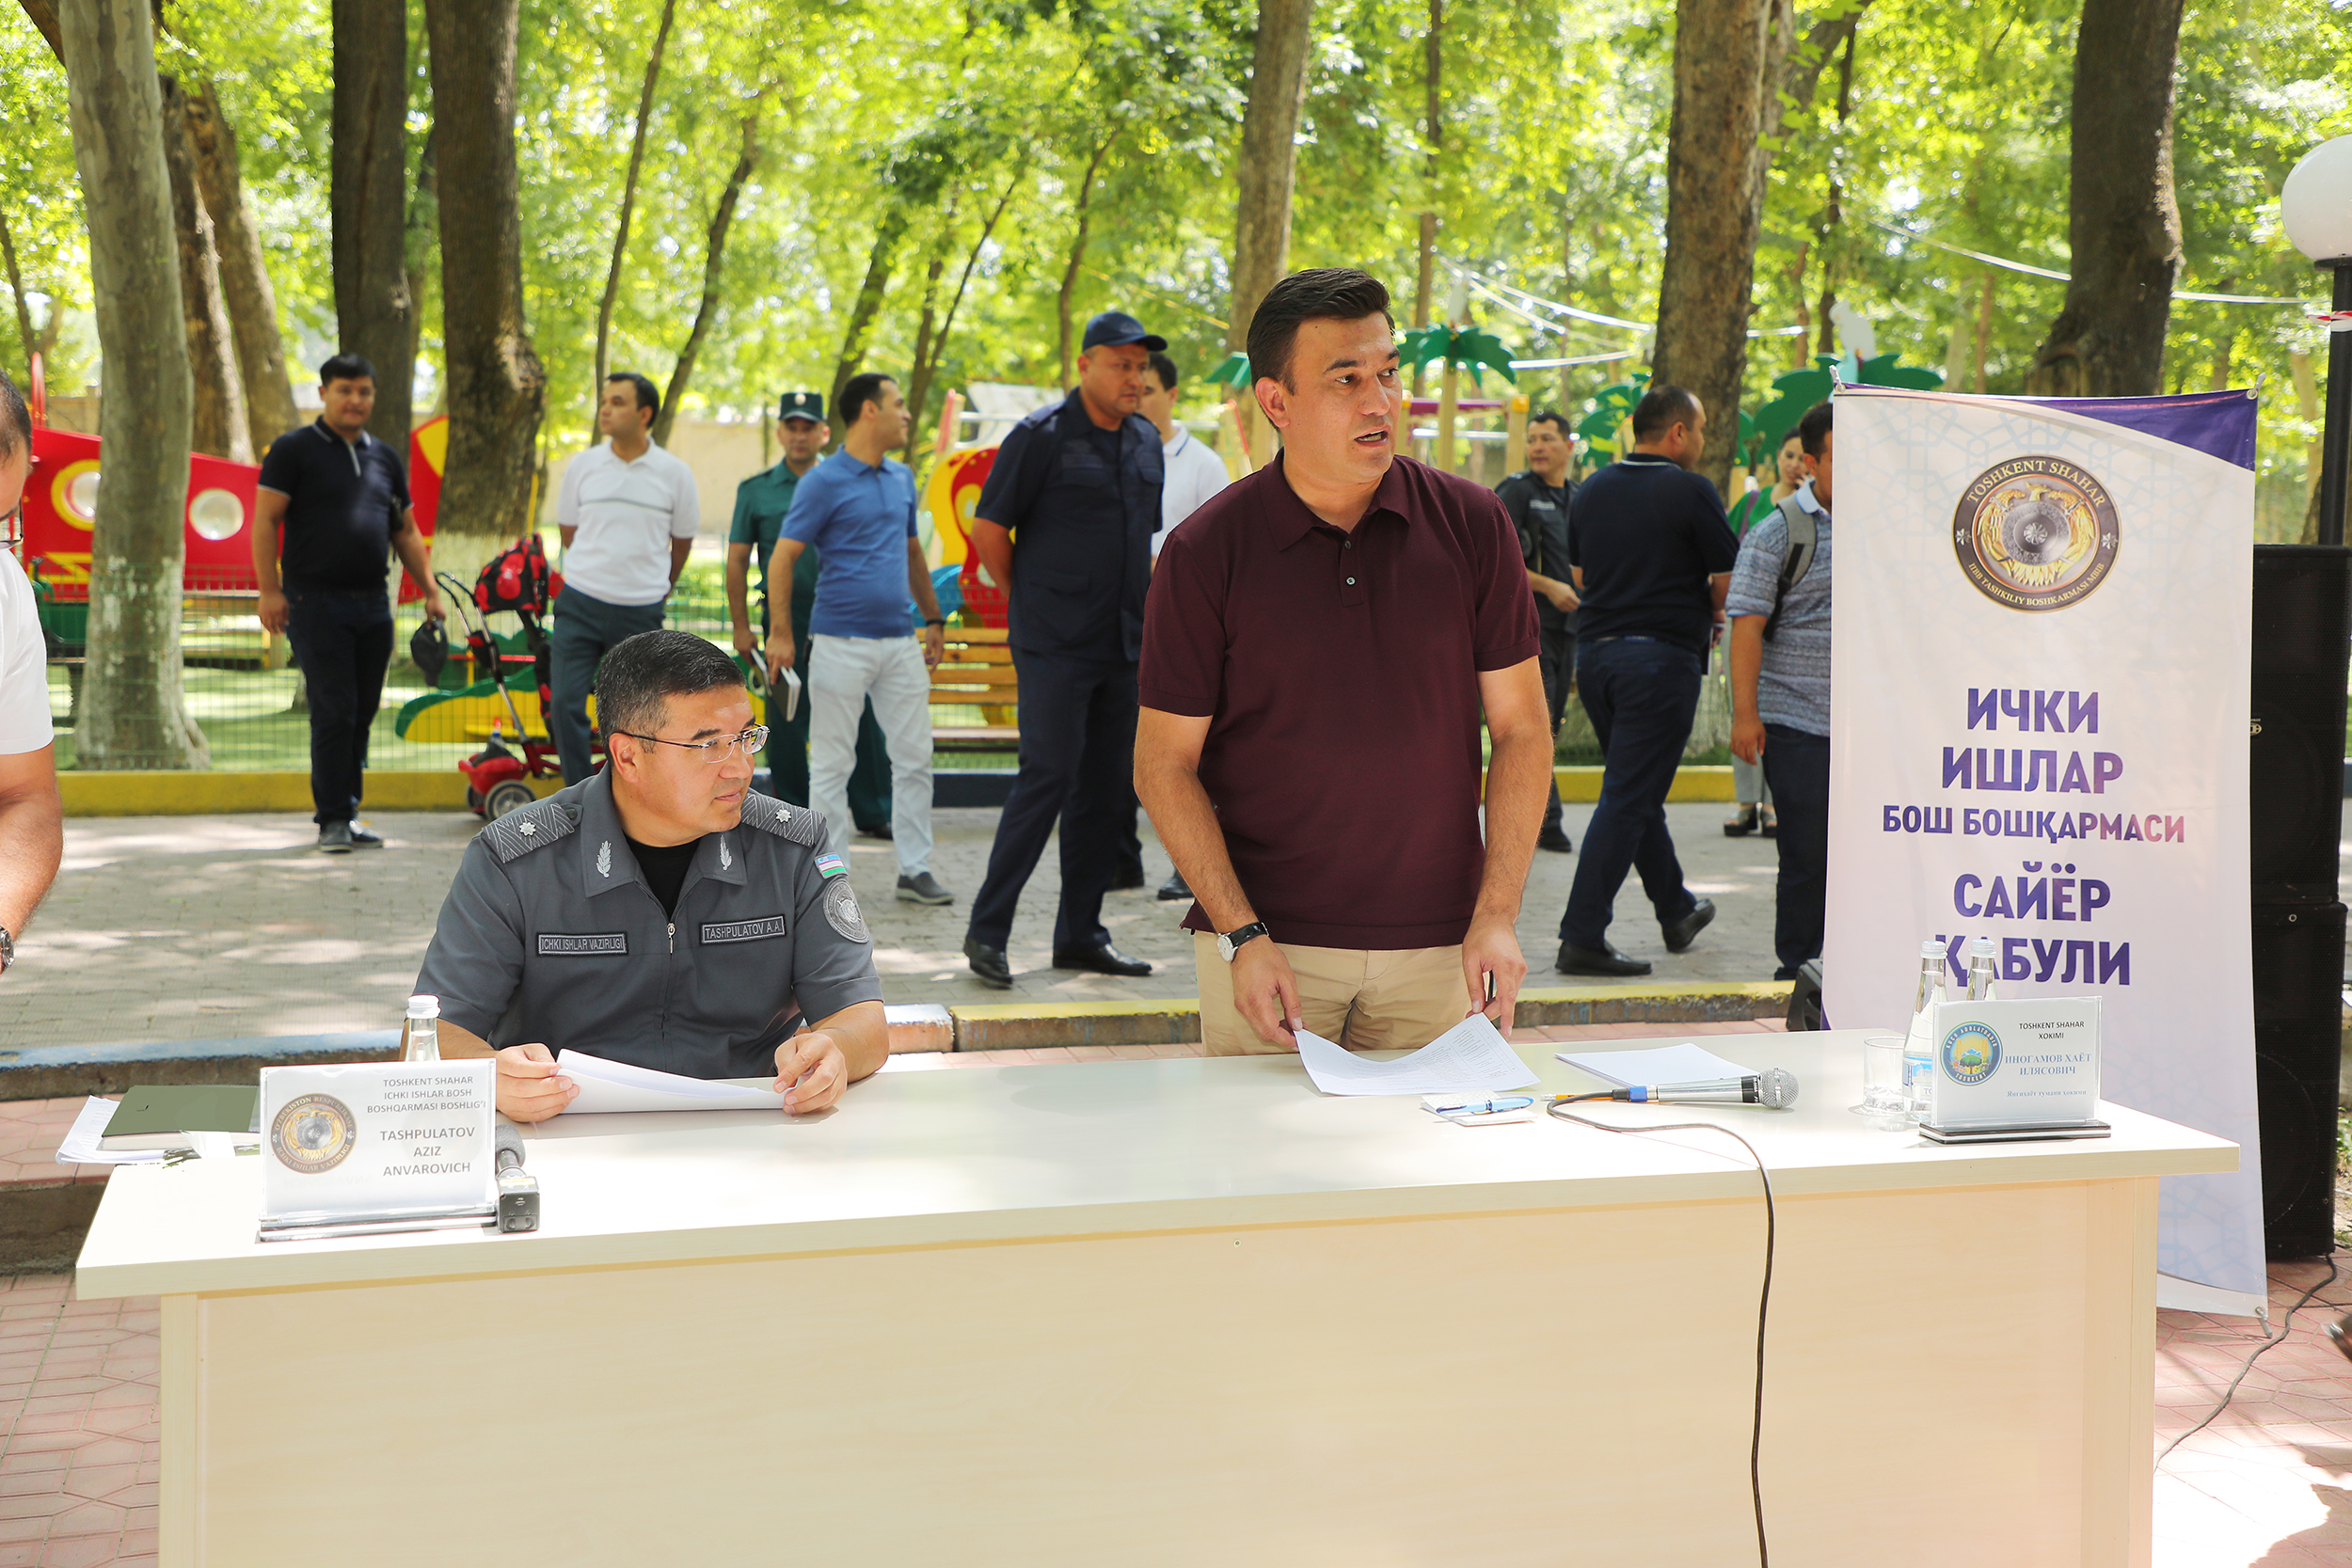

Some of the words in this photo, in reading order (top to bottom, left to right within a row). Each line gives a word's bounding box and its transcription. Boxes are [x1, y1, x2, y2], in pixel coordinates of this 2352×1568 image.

[1966, 460, 2046, 503] TOSHKENT
[2049, 462, 2106, 508] SHAHAR
[1980, 577, 2026, 605] TASHKILIY
[2026, 581, 2090, 606] BOSHKARMASI
[1967, 688, 2099, 734] ИЧКИ
[1942, 746, 2124, 794] ИШЛАР
[1883, 805, 1953, 834] БОШ
[1963, 808, 2185, 844] БОШҚАРМАСИ
[1953, 861, 2111, 922] САЙЁР
[705, 922, 764, 940] TASHPULATOV
[541, 938, 562, 950] ICHKI
[563, 939, 588, 950] ISHLAR
[589, 938, 624, 950] VAZIRLIGI
[2019, 1022, 2055, 1030] TOSHKENT
[2056, 1021, 2085, 1029] SHAHAR
[2038, 1032, 2064, 1040] XOKIMI
[2005, 1053, 2063, 1064] ИНОГАМОВ
[2064, 1052, 2092, 1063] ХАЁТ
[2019, 1066, 2076, 1075] ИЛЯСОВИЧ
[383, 1077, 433, 1087] TOSHKENT
[435, 1076, 473, 1085] SHAHAR
[384, 1091, 409, 1100] ICHKI
[411, 1090, 444, 1099] ISHLAR
[446, 1088, 472, 1098] BOSH
[367, 1102, 438, 1114] BOSHQARMASI
[380, 1127, 475, 1141] TASHPULATOV
[413, 1146, 442, 1158] AZIZ
[383, 1162, 471, 1177] ANVAROVICH
